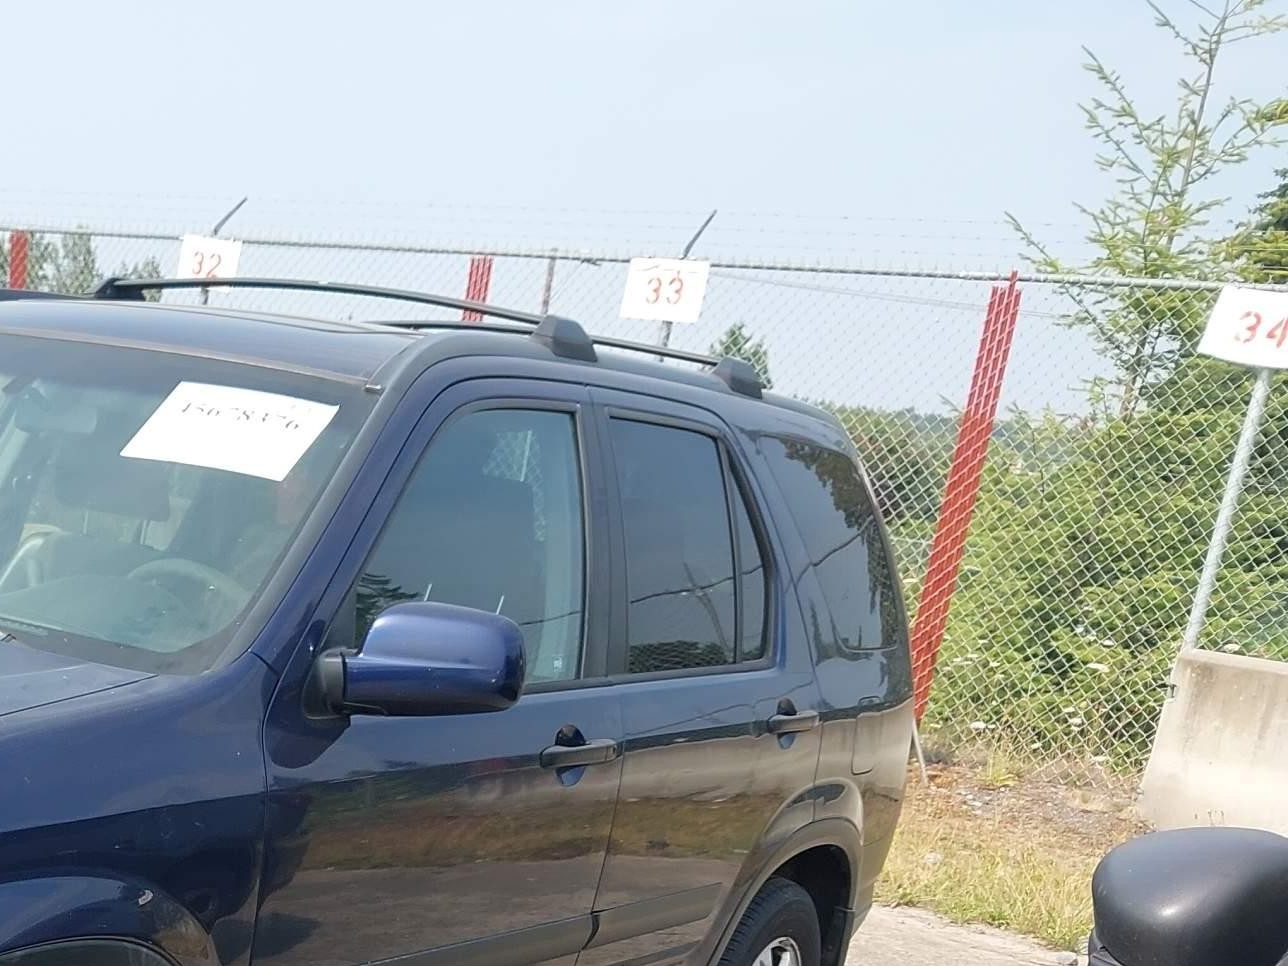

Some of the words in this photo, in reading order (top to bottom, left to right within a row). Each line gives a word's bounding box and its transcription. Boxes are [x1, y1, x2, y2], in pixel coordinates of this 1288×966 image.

[192, 251, 222, 281] 32
[645, 277, 684, 305] 33
[1233, 310, 1288, 349] 34
